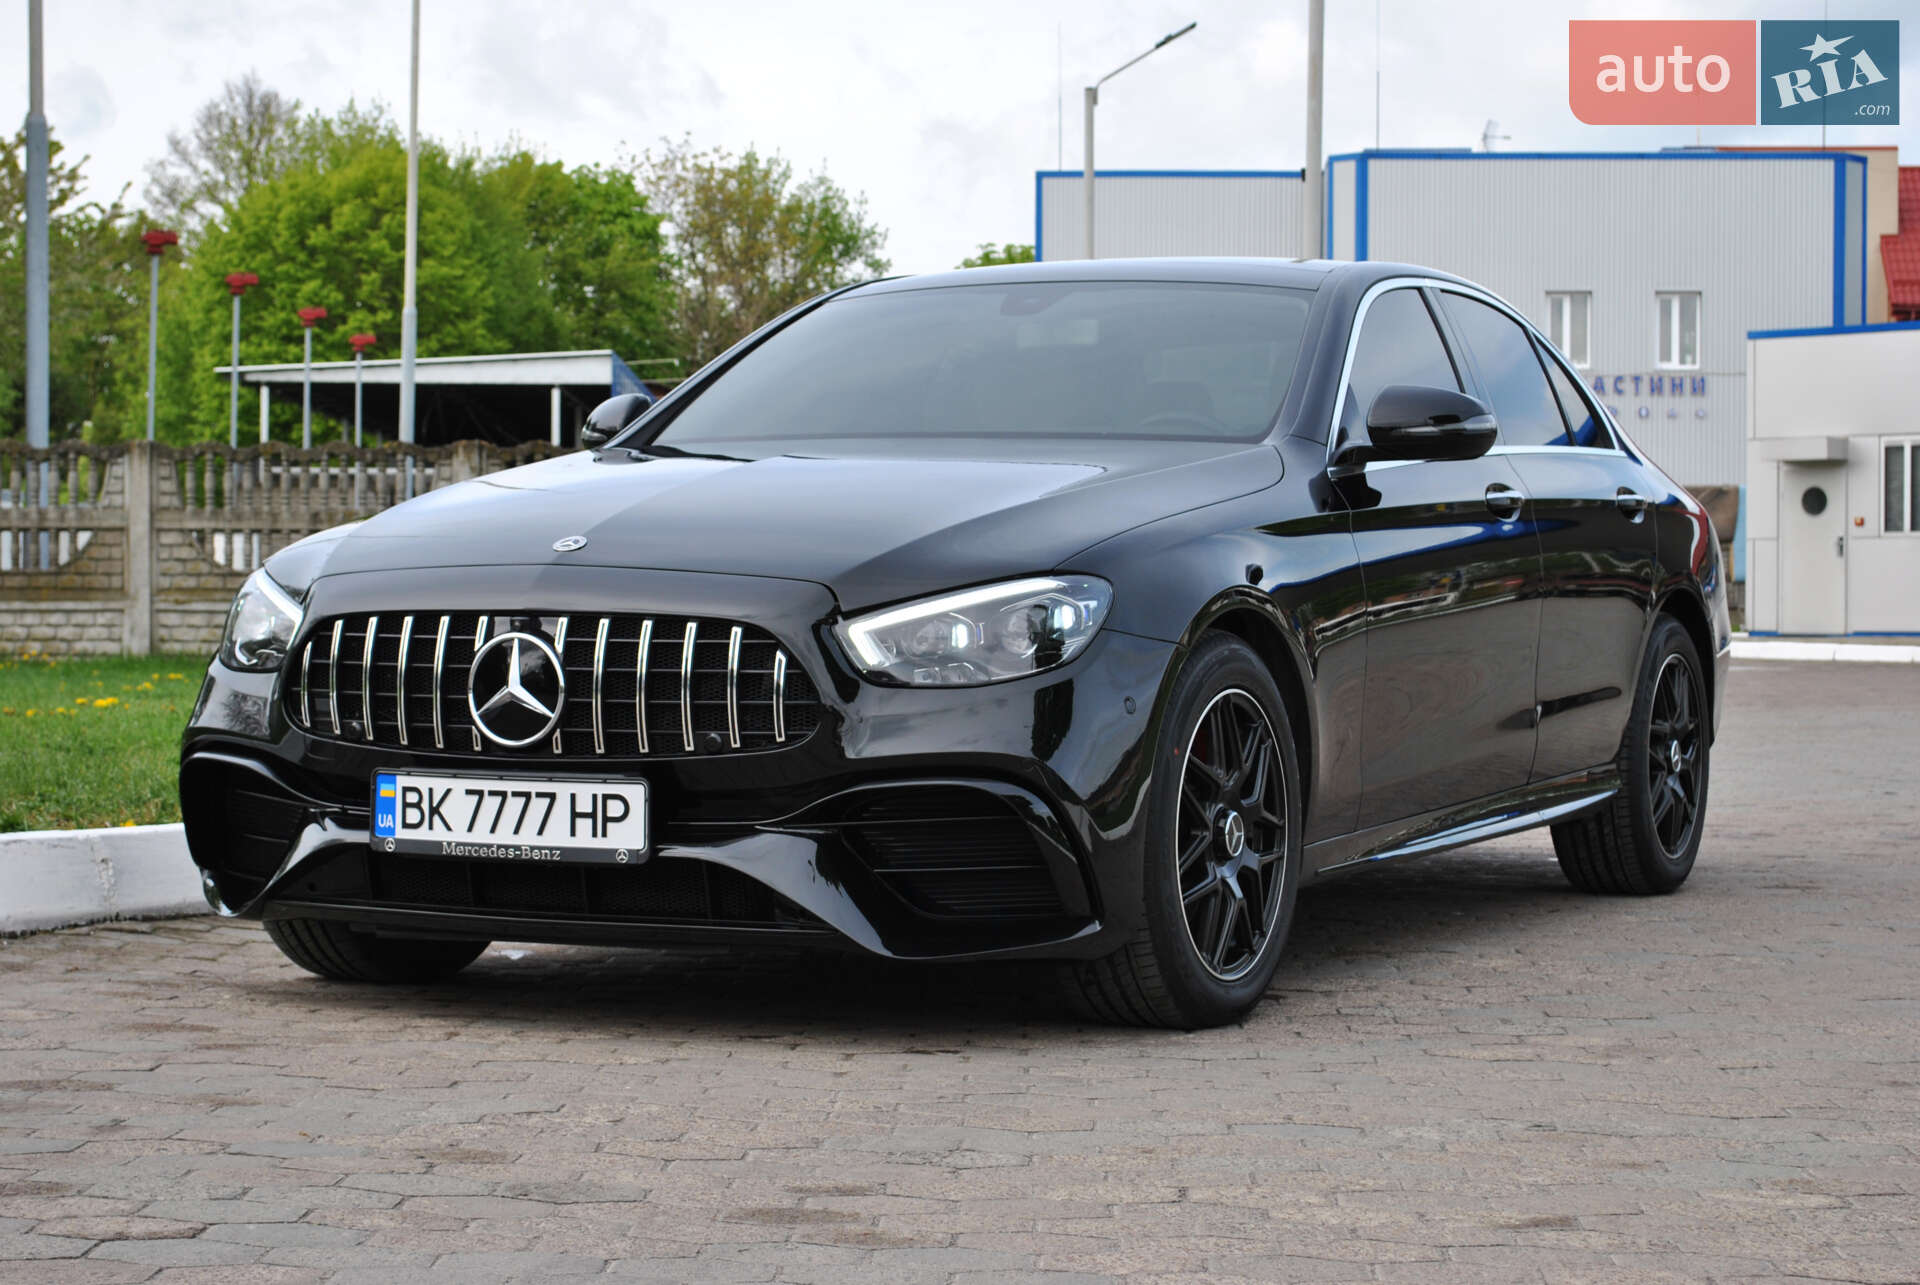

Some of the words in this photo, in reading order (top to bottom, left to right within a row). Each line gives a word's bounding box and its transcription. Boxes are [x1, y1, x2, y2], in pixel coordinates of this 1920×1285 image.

[378, 813, 394, 828] UA
[401, 786, 453, 832] BK
[465, 789, 557, 836] 7777
[569, 793, 630, 838] HP
[442, 841, 561, 861] Mercedes-Benz
